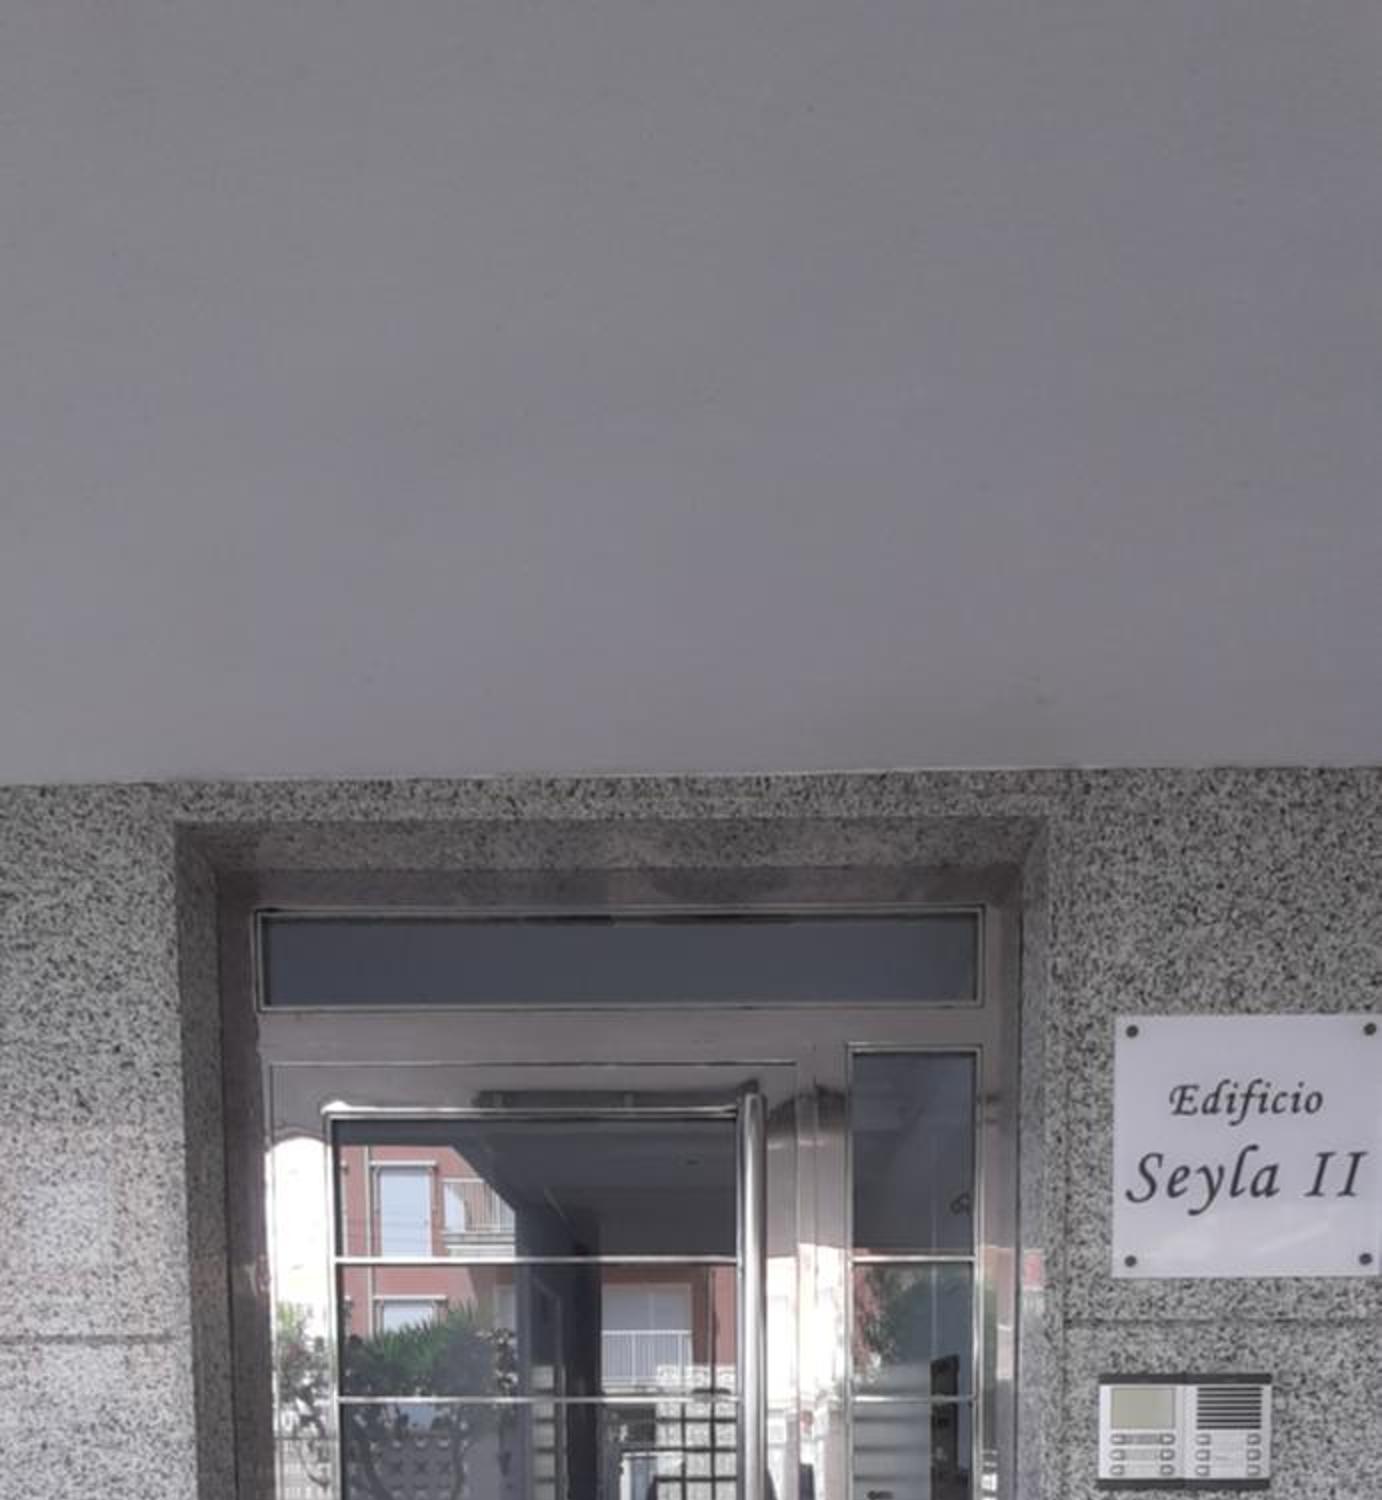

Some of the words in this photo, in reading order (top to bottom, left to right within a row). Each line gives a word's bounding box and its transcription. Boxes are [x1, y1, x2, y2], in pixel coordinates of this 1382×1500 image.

[1168, 1078, 1324, 1127] Edificio
[1125, 1144, 1280, 1216] Seyla
[1304, 1151, 1369, 1198] II
